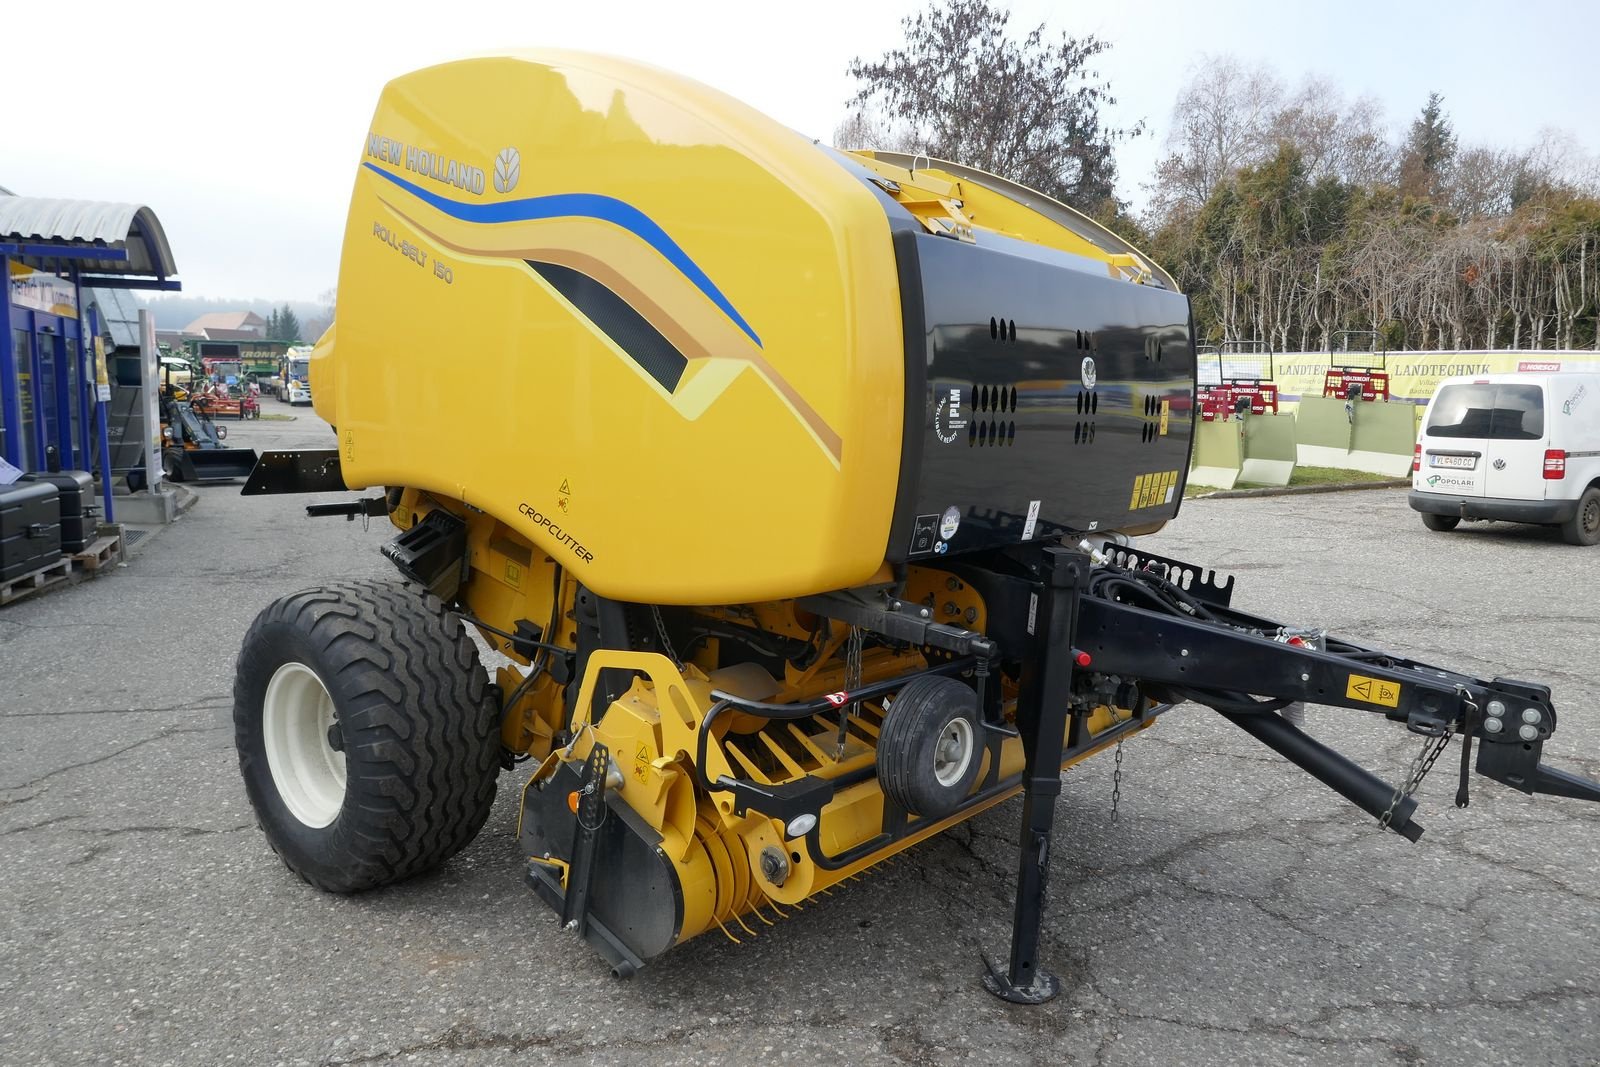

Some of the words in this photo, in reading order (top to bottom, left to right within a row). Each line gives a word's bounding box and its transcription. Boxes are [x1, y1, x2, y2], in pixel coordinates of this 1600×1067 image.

[367, 132, 404, 166] NEW
[406, 145, 486, 196] HOLLAND
[373, 221, 428, 268] ROLL-BELT
[433, 259, 454, 285] 150
[1394, 364, 1491, 376] LANDTECHNIK
[949, 388, 961, 418] PLM
[1433, 474, 1475, 487] POPOLARI
[518, 503, 594, 565] CROPCUTTER
